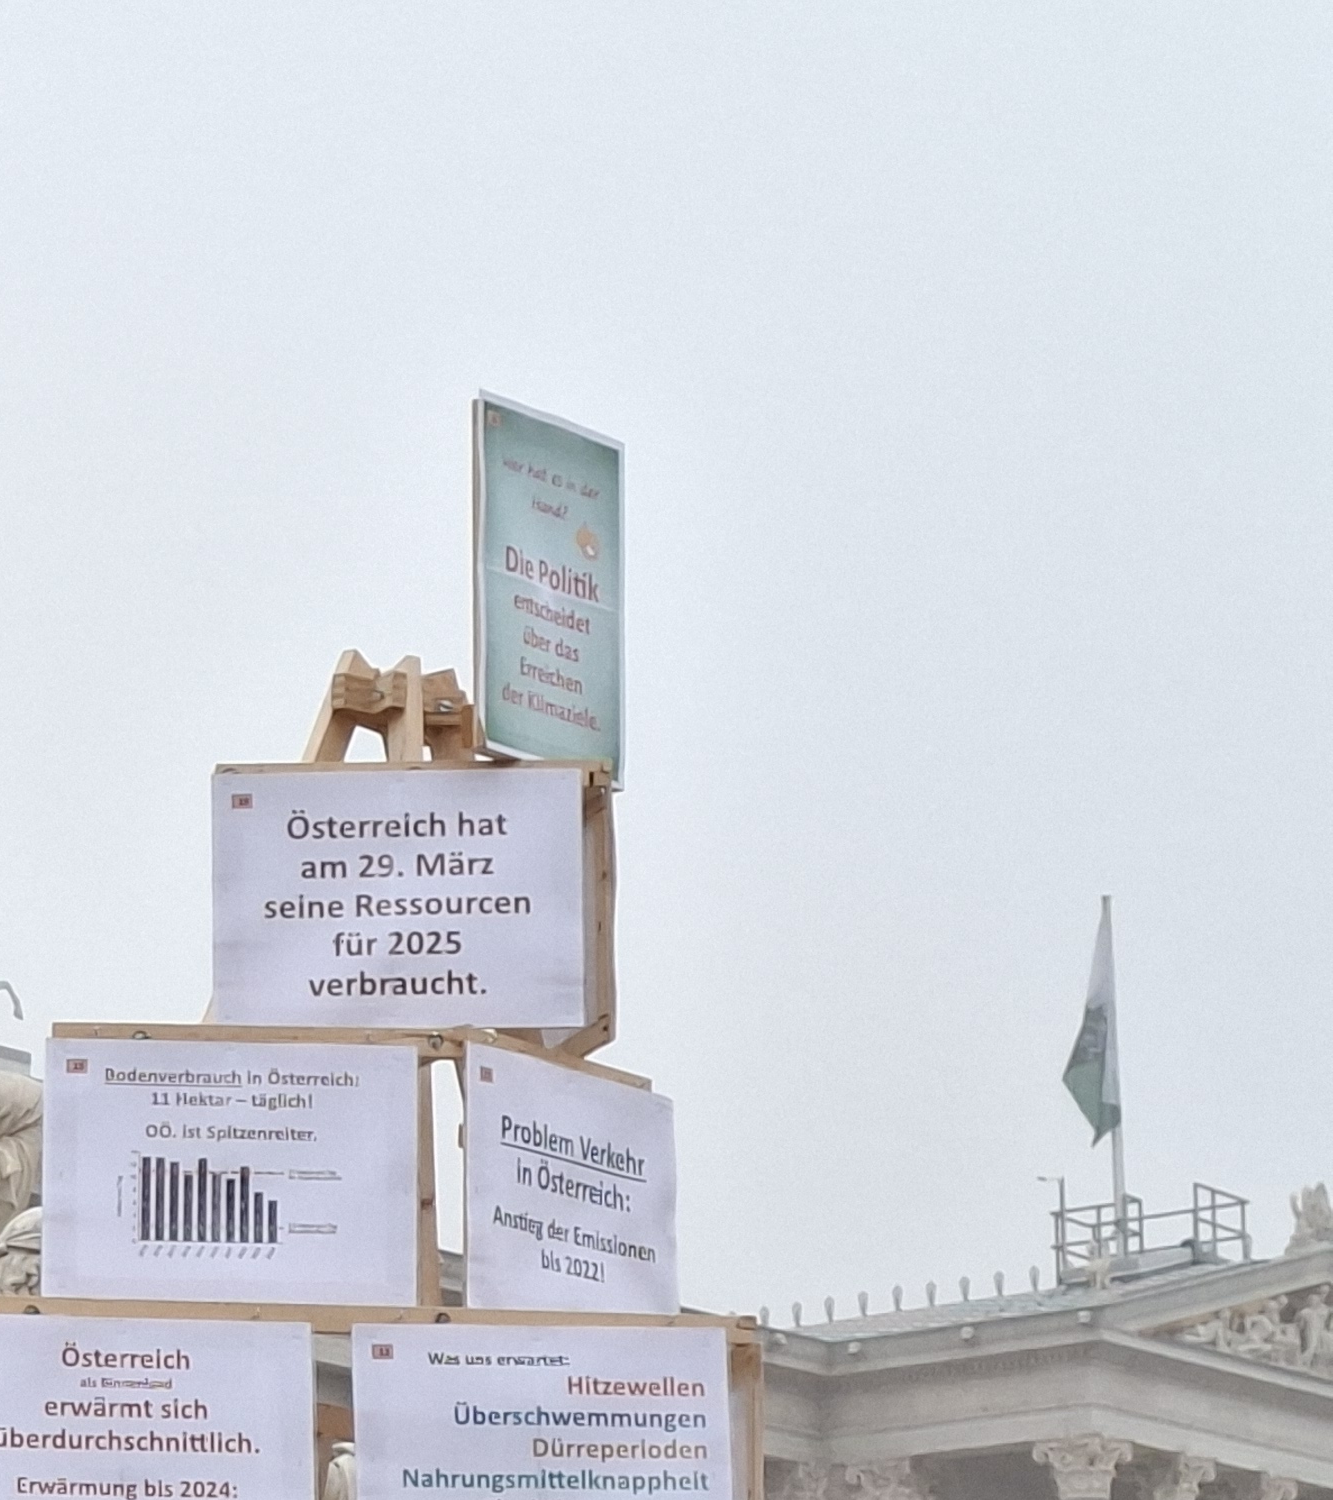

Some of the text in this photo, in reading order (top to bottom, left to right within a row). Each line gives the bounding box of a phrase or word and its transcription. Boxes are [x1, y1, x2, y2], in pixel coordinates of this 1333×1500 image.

[505, 546, 600, 602] Die Politik
[514, 594, 591, 635] entscheidet
[523, 626, 579, 662] über das
[520, 656, 583, 695] Erreichen
[502, 682, 601, 732] der Klimaziele.
[287, 810, 507, 839] Österreich hat
[301, 851, 494, 879] am 29. März
[264, 893, 531, 919] seine Ressourcen
[333, 931, 462, 957] für 2025
[309, 970, 487, 997] verbraucht.
[105, 1067, 360, 1087] Bodenverbrauch in Österreich:
[151, 1092, 170, 1106] 11
[176, 1092, 232, 1107] Hektar
[252, 1093, 313, 1111] täglich!
[183, 1124, 201, 1139] ist
[501, 1115, 645, 1177] Problem Verkehr
[517, 1157, 631, 1213] in Österreich:
[493, 1205, 656, 1264] Anstieg der Emissionen
[541, 1249, 605, 1283] bis 2022!
[62, 1342, 191, 1370] Österreich
[568, 1375, 705, 1397] Hitzewellen
[45, 1397, 208, 1420] erwärmt sich
[454, 1402, 706, 1432] Überschwemmungen
[533, 1438, 708, 1462] Dürreperioden
[17, 1477, 238, 1500] Erwärmung bis 2024:
[403, 1469, 709, 1495] Nahrungsmittelknappheit
